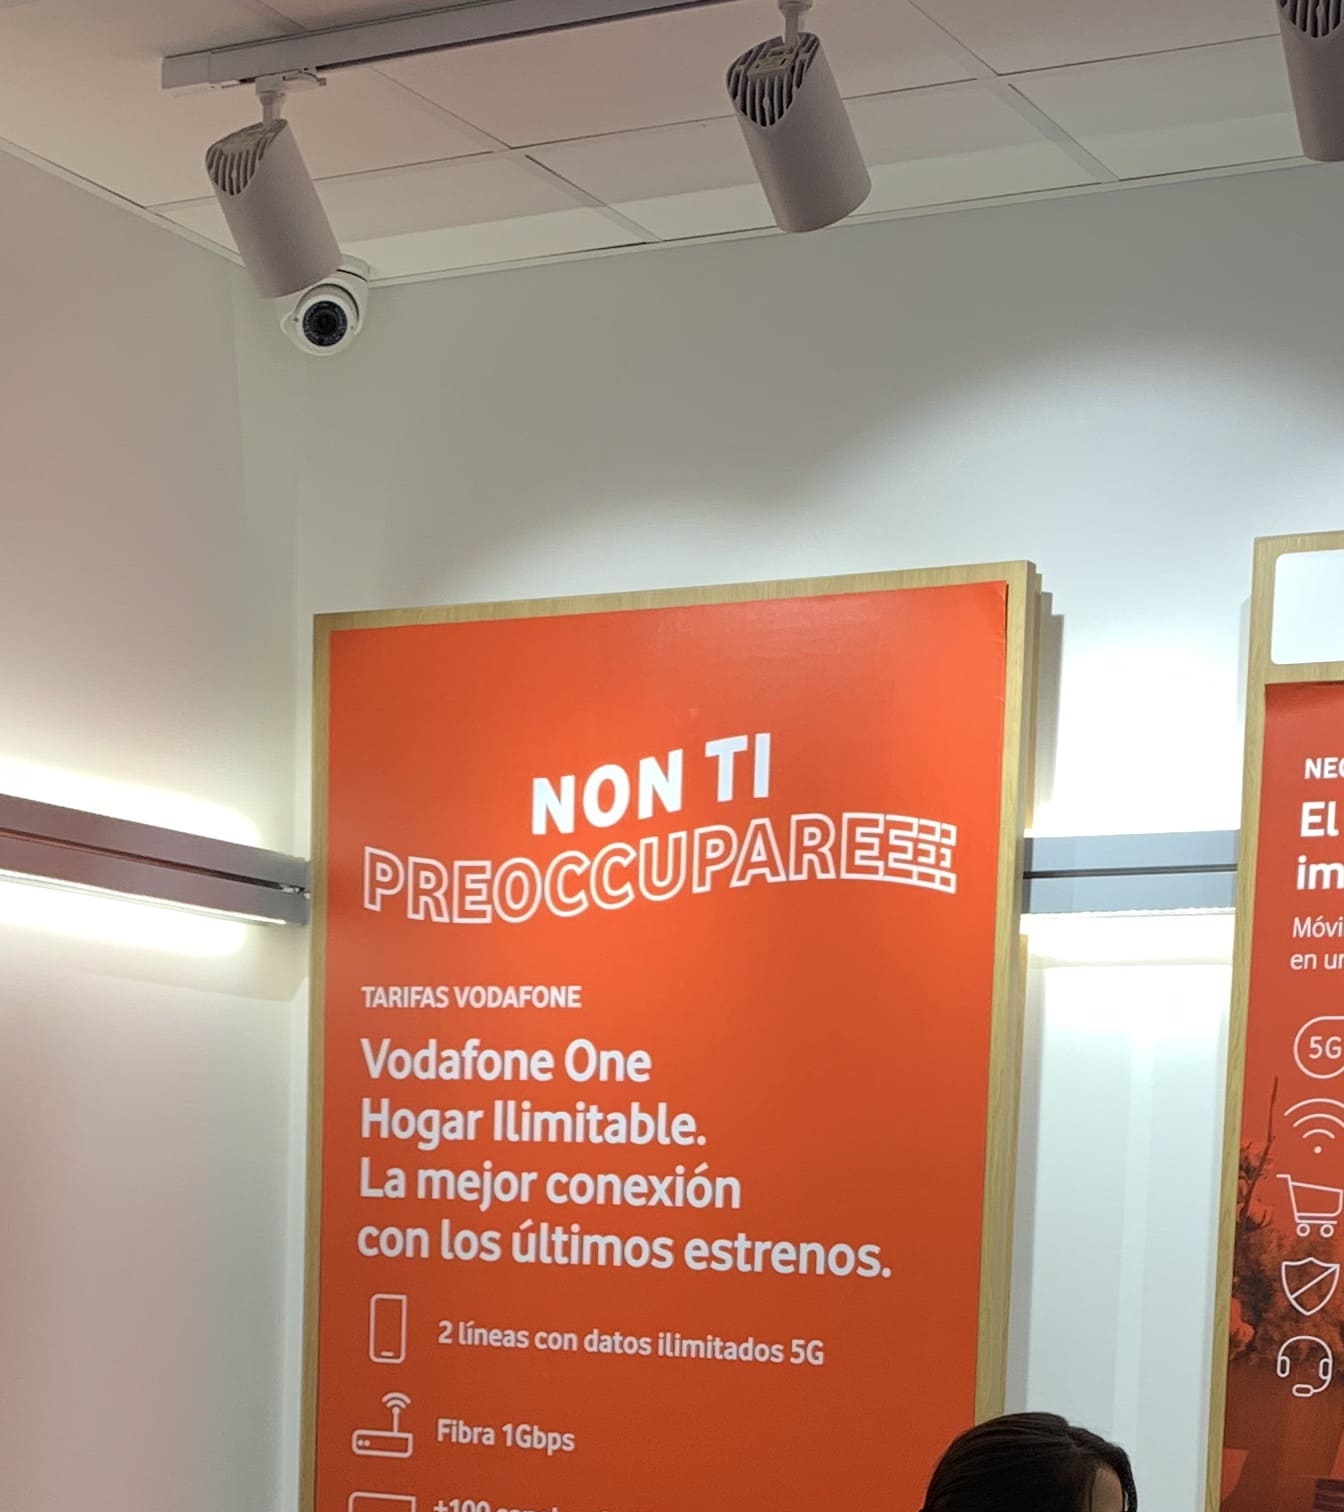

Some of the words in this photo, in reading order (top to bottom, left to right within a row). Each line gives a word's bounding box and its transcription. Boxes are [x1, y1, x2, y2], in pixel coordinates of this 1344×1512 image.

[531, 749, 684, 836] NON
[705, 733, 772, 803] TI
[1299, 801, 1339, 838] El
[1290, 951, 1318, 970] en
[362, 984, 450, 1009] TARIFAS
[453, 985, 582, 1010] VODAFONE
[360, 1038, 554, 1082] Vodafone
[564, 1040, 652, 1083] One
[1308, 1035, 1342, 1060] 5G
[361, 1098, 484, 1151] Hogar
[493, 1102, 707, 1146] Ilimitable.
[359, 1157, 405, 1199] La
[417, 1162, 537, 1213] mejor
[545, 1162, 742, 1209] conexión
[357, 1223, 430, 1258] con
[440, 1220, 502, 1262] los
[512, 1220, 674, 1270] últimos
[684, 1239, 892, 1278] estrenos.
[438, 1321, 453, 1344] 2
[458, 1321, 529, 1350] líneas
[534, 1330, 578, 1351] con
[583, 1330, 652, 1356] datos
[657, 1332, 784, 1363] ilimitados
[790, 1339, 825, 1365] 5G
[437, 1418, 496, 1447] Fibra
[503, 1424, 575, 1456] 1Gbps
